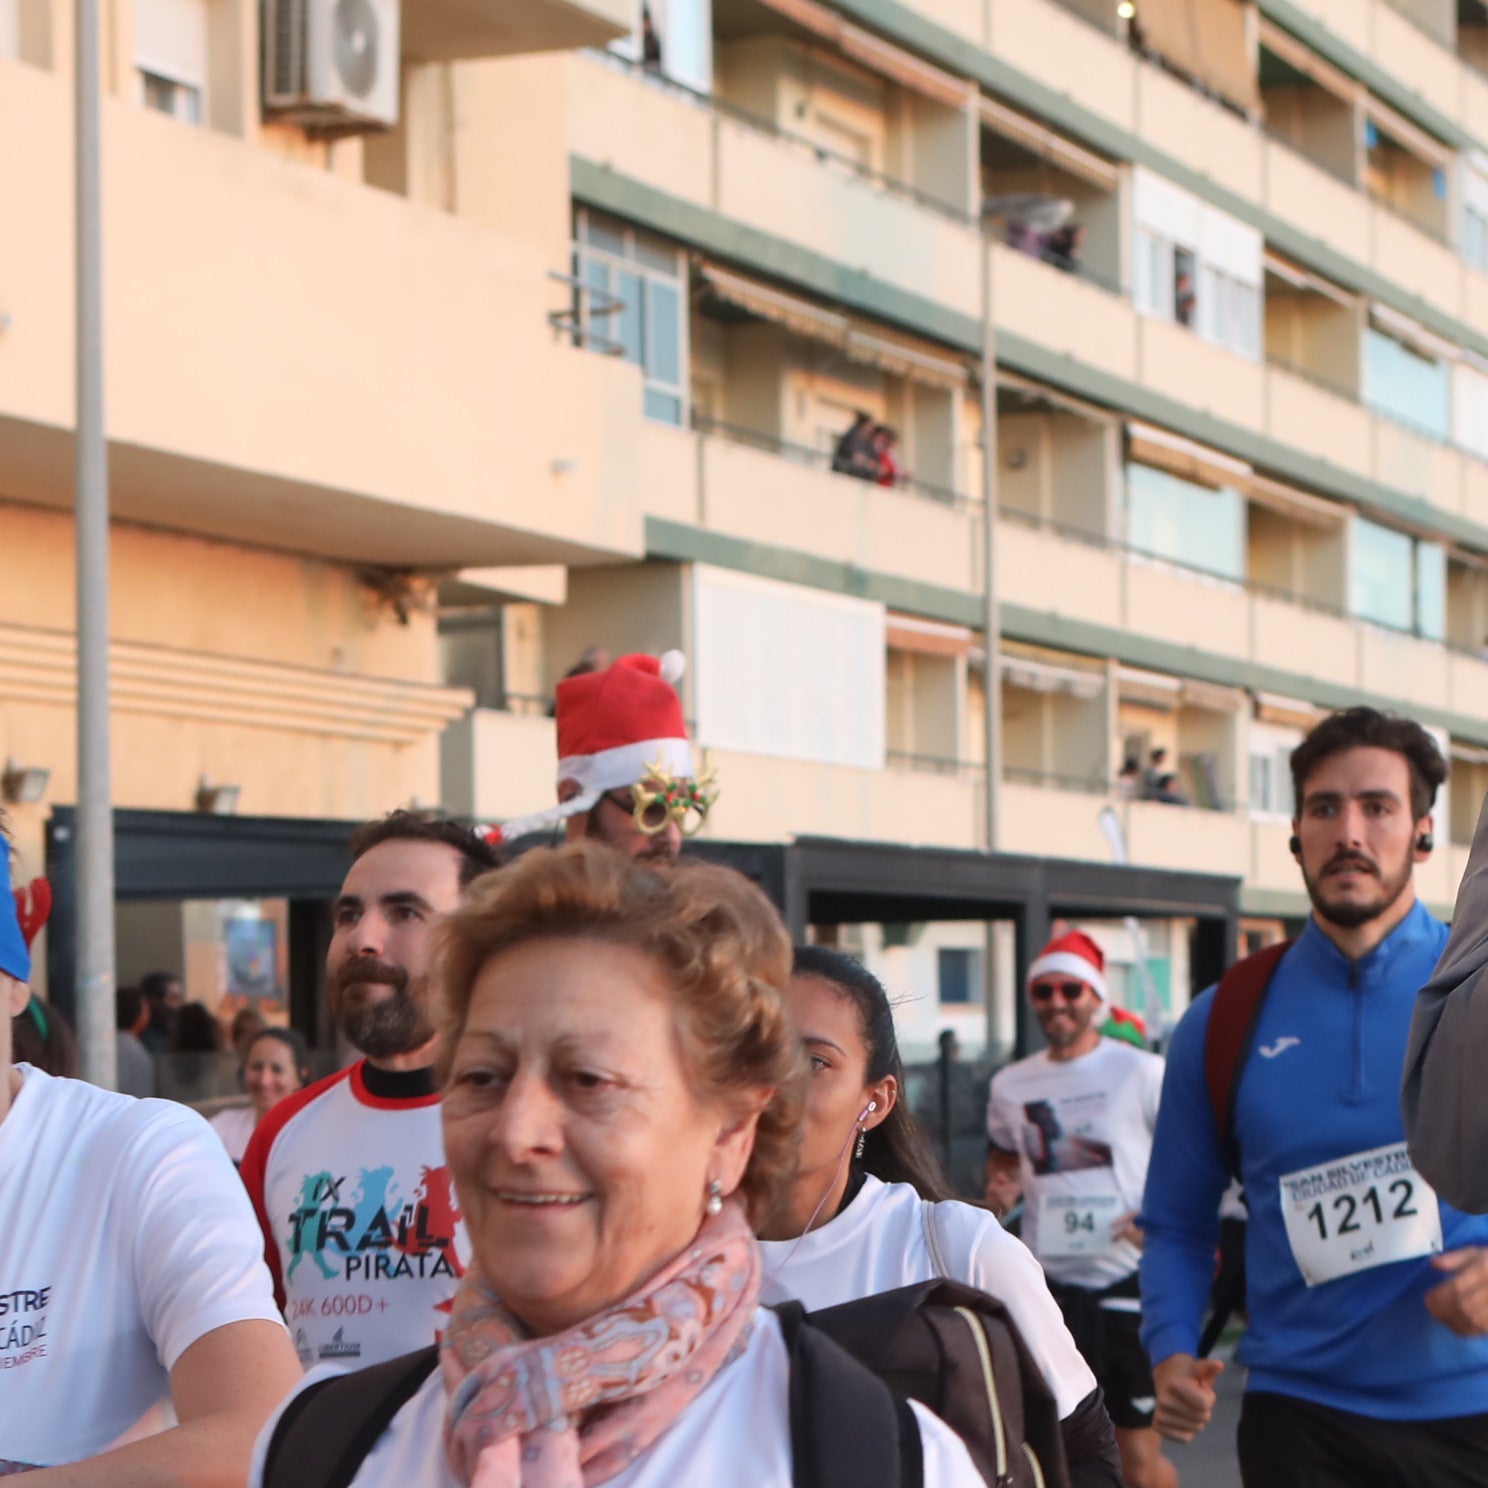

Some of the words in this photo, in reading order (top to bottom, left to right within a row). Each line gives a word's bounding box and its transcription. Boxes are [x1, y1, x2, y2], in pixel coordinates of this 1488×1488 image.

[1327, 1151, 1407, 1180] SILVESTR
[312, 1176, 347, 1202] IX
[1063, 1210, 1095, 1234] 94
[1308, 1179, 1418, 1241] 1212
[345, 1253, 455, 1281] PIRATA
